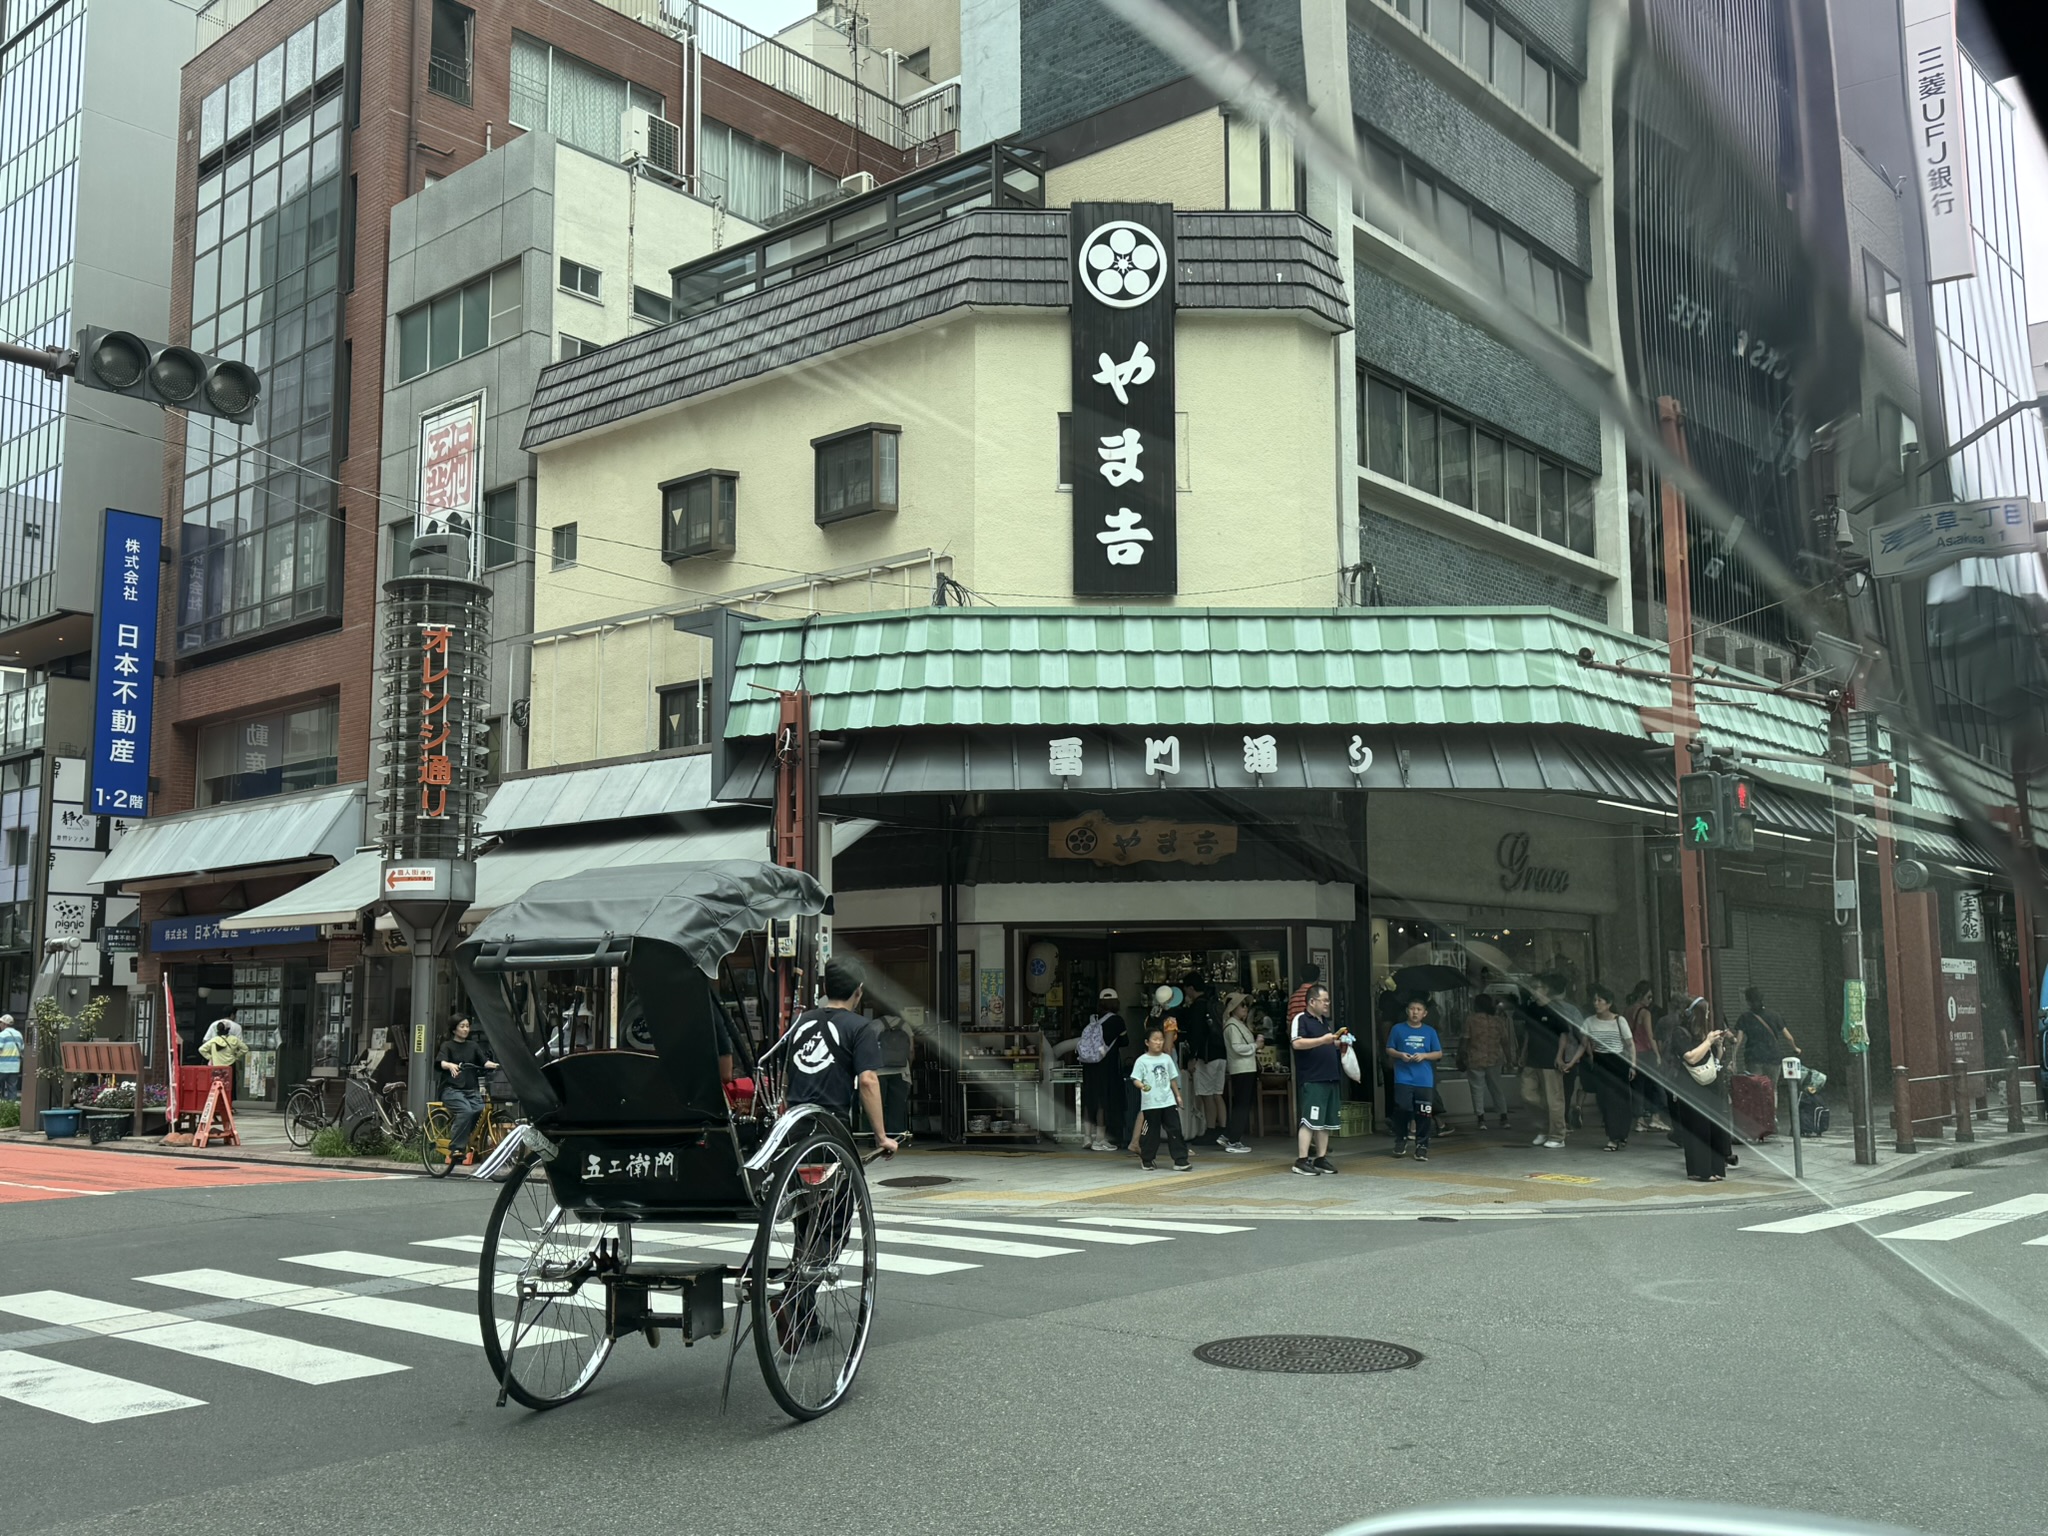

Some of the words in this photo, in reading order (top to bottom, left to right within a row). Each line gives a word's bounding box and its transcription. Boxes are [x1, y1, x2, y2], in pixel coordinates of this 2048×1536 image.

[1917, 45, 1955, 217] 三菱UFJ銀行
[123, 538, 141, 602] 株式会社
[109, 623, 139, 764] 日本不動産
[418, 626, 453, 817] オレンジ通り
